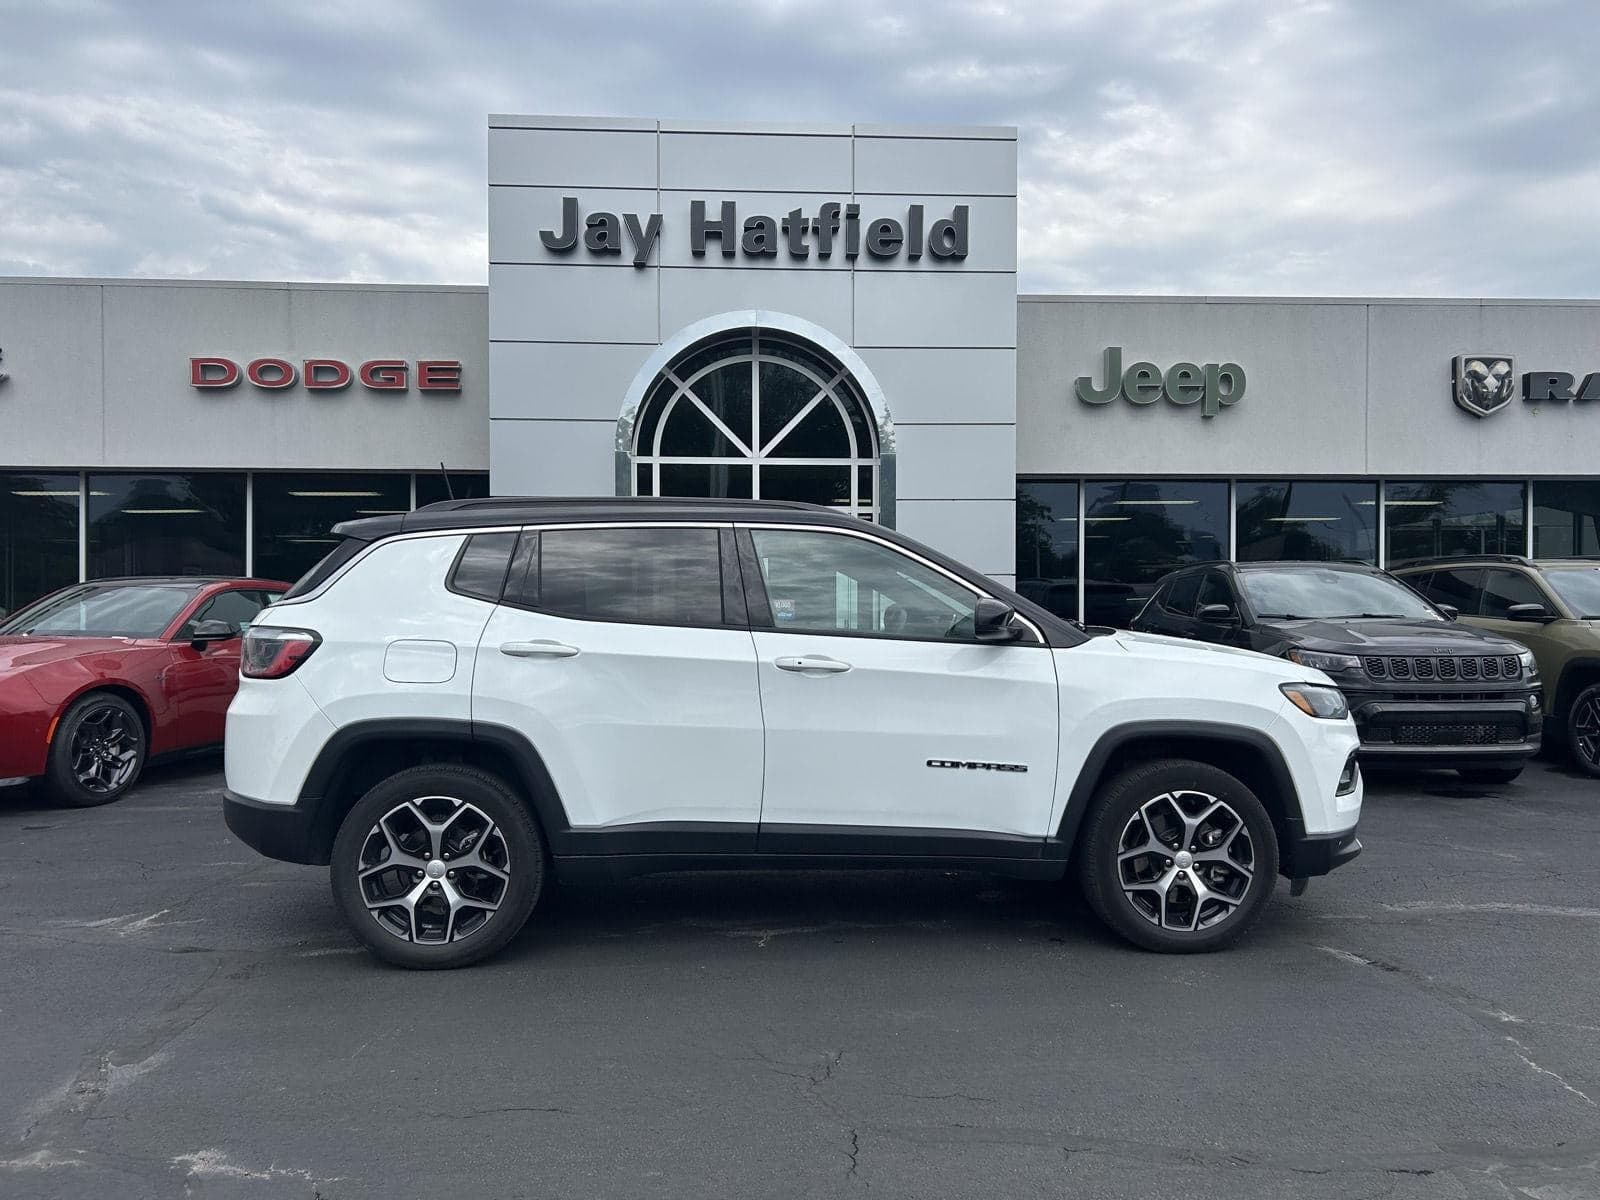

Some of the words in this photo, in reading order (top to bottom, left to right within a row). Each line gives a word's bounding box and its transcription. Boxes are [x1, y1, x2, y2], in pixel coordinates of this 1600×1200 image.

[539, 197, 663, 268] Jay
[690, 200, 969, 260] Hatfield
[189, 357, 462, 391] DODGE
[1075, 347, 1247, 417] Jeep
[926, 760, 1028, 772] COMPASS
